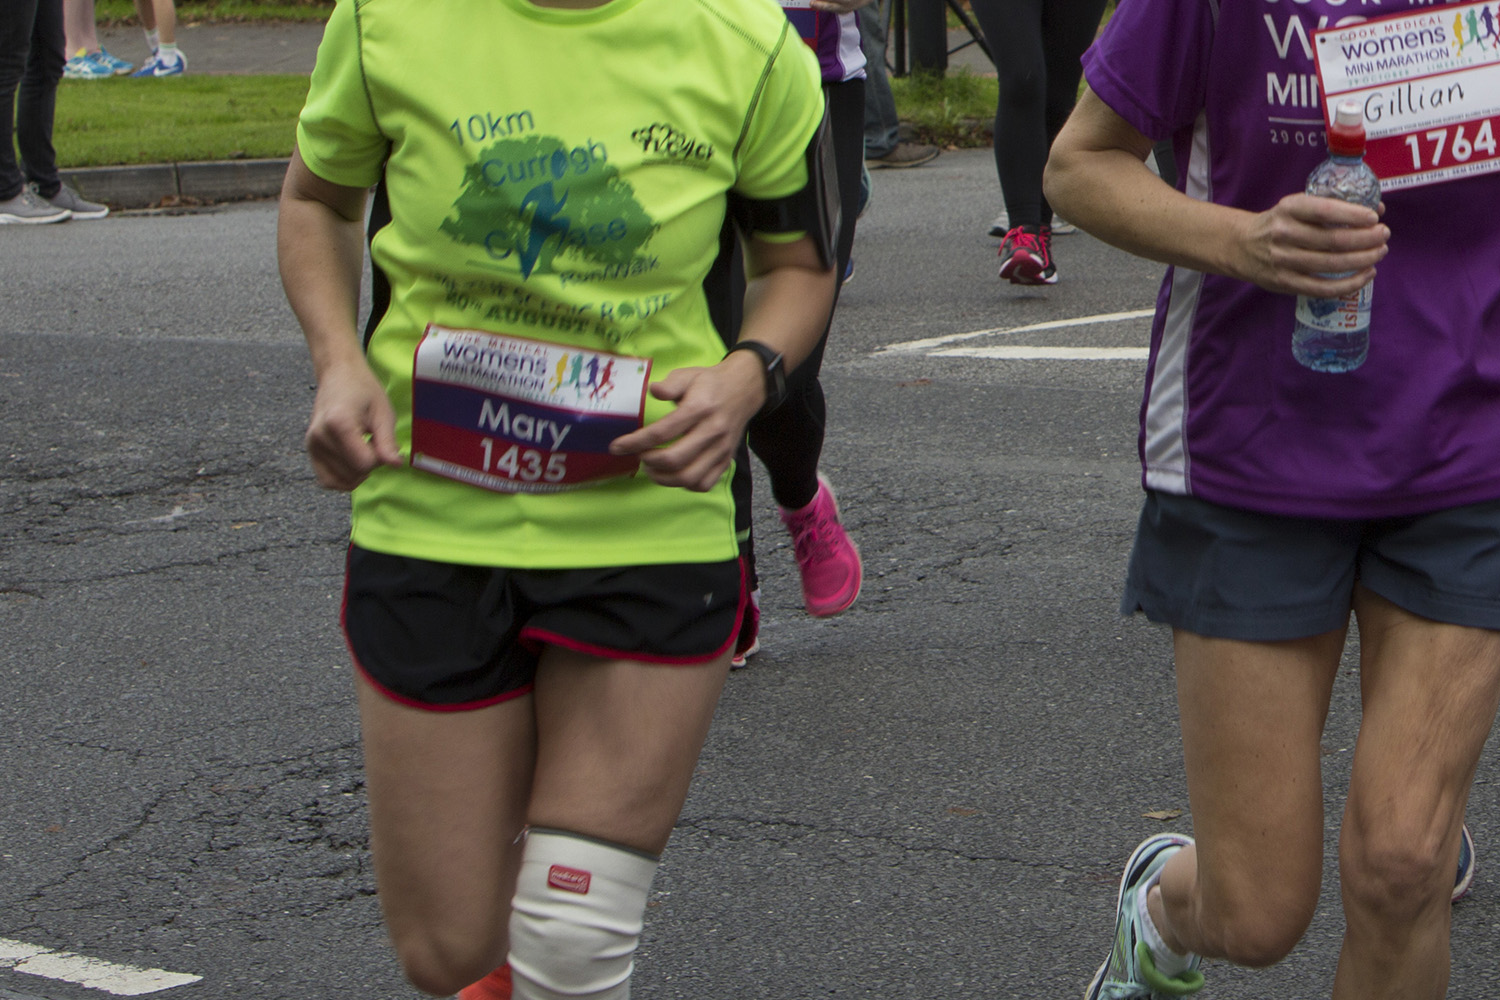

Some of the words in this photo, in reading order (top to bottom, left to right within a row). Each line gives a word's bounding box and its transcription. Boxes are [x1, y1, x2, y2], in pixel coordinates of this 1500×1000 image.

[1339, 27, 1376, 42] COOK
[1384, 16, 1443, 34] MEDICAL
[1341, 26, 1446, 61] womens
[1345, 59, 1374, 77] MINI
[1376, 47, 1450, 71] MARATHON
[1364, 82, 1465, 123] Gillian
[449, 109, 535, 147] 10km
[1270, 130, 1289, 144] 29
[1405, 118, 1497, 170] 1764
[444, 341, 547, 376] womens
[471, 367, 546, 391] MARATHON
[477, 398, 572, 451] Mary
[479, 437, 567, 482] 1435
